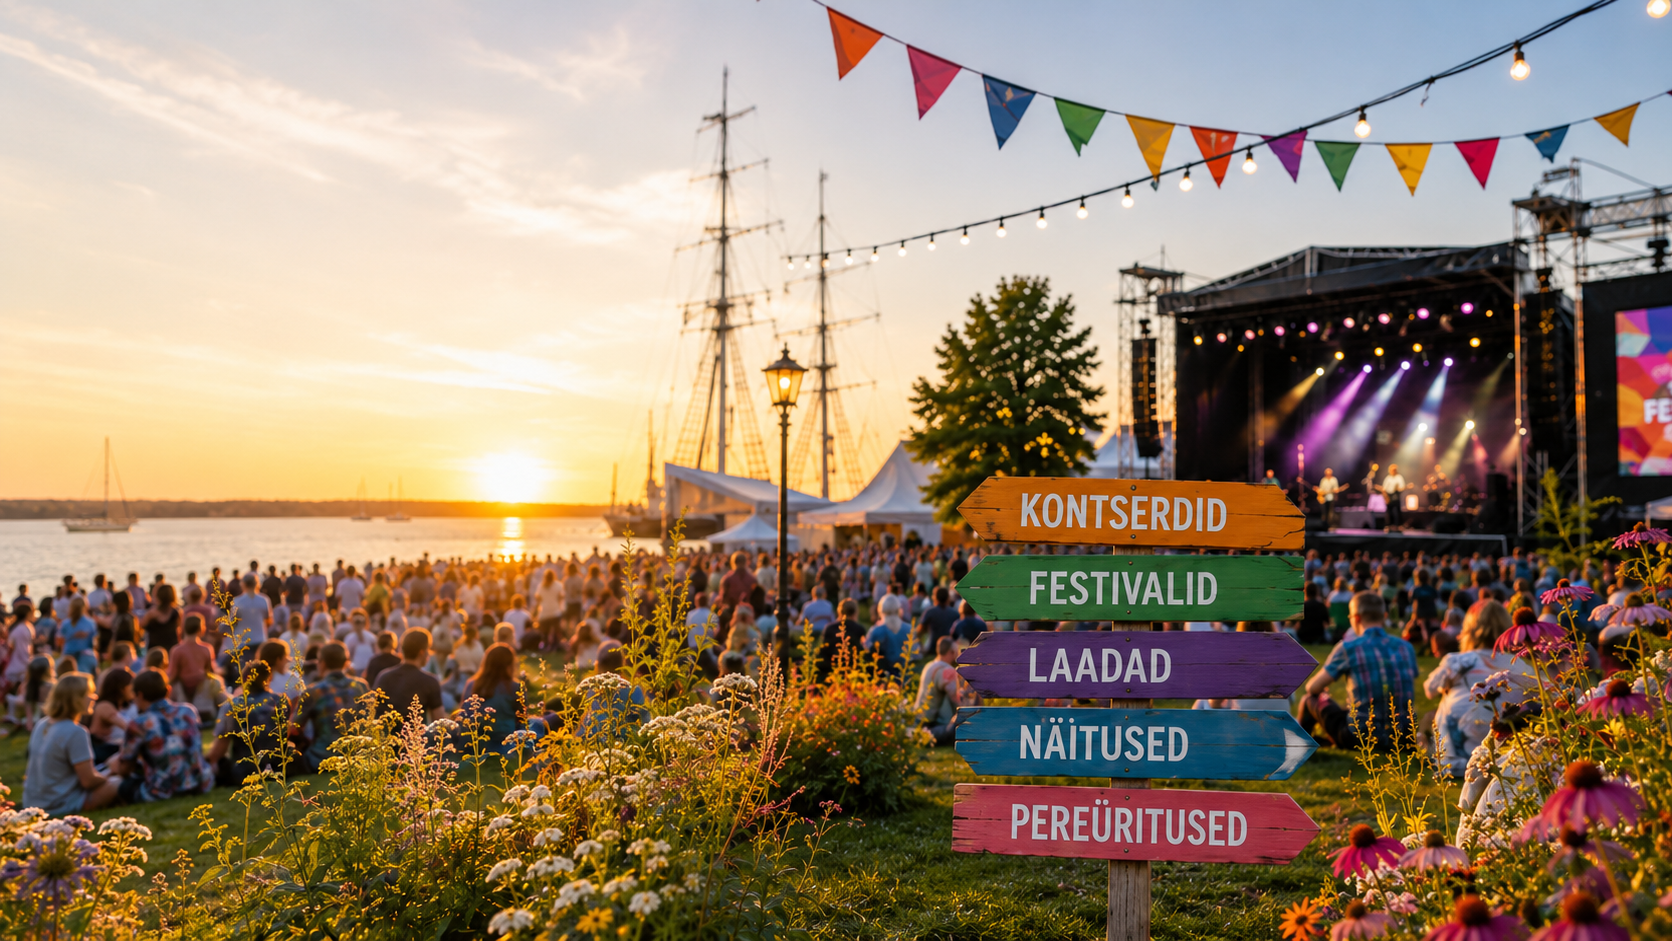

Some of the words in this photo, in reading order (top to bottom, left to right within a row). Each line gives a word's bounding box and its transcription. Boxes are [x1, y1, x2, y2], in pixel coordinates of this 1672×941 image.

[1020, 493, 1227, 532] KONTSERDID
[1030, 571, 1218, 605] FESTIVALID
[1029, 648, 1171, 683] LAADAD
[1011, 799, 1247, 846] PEREÜRITUSED
